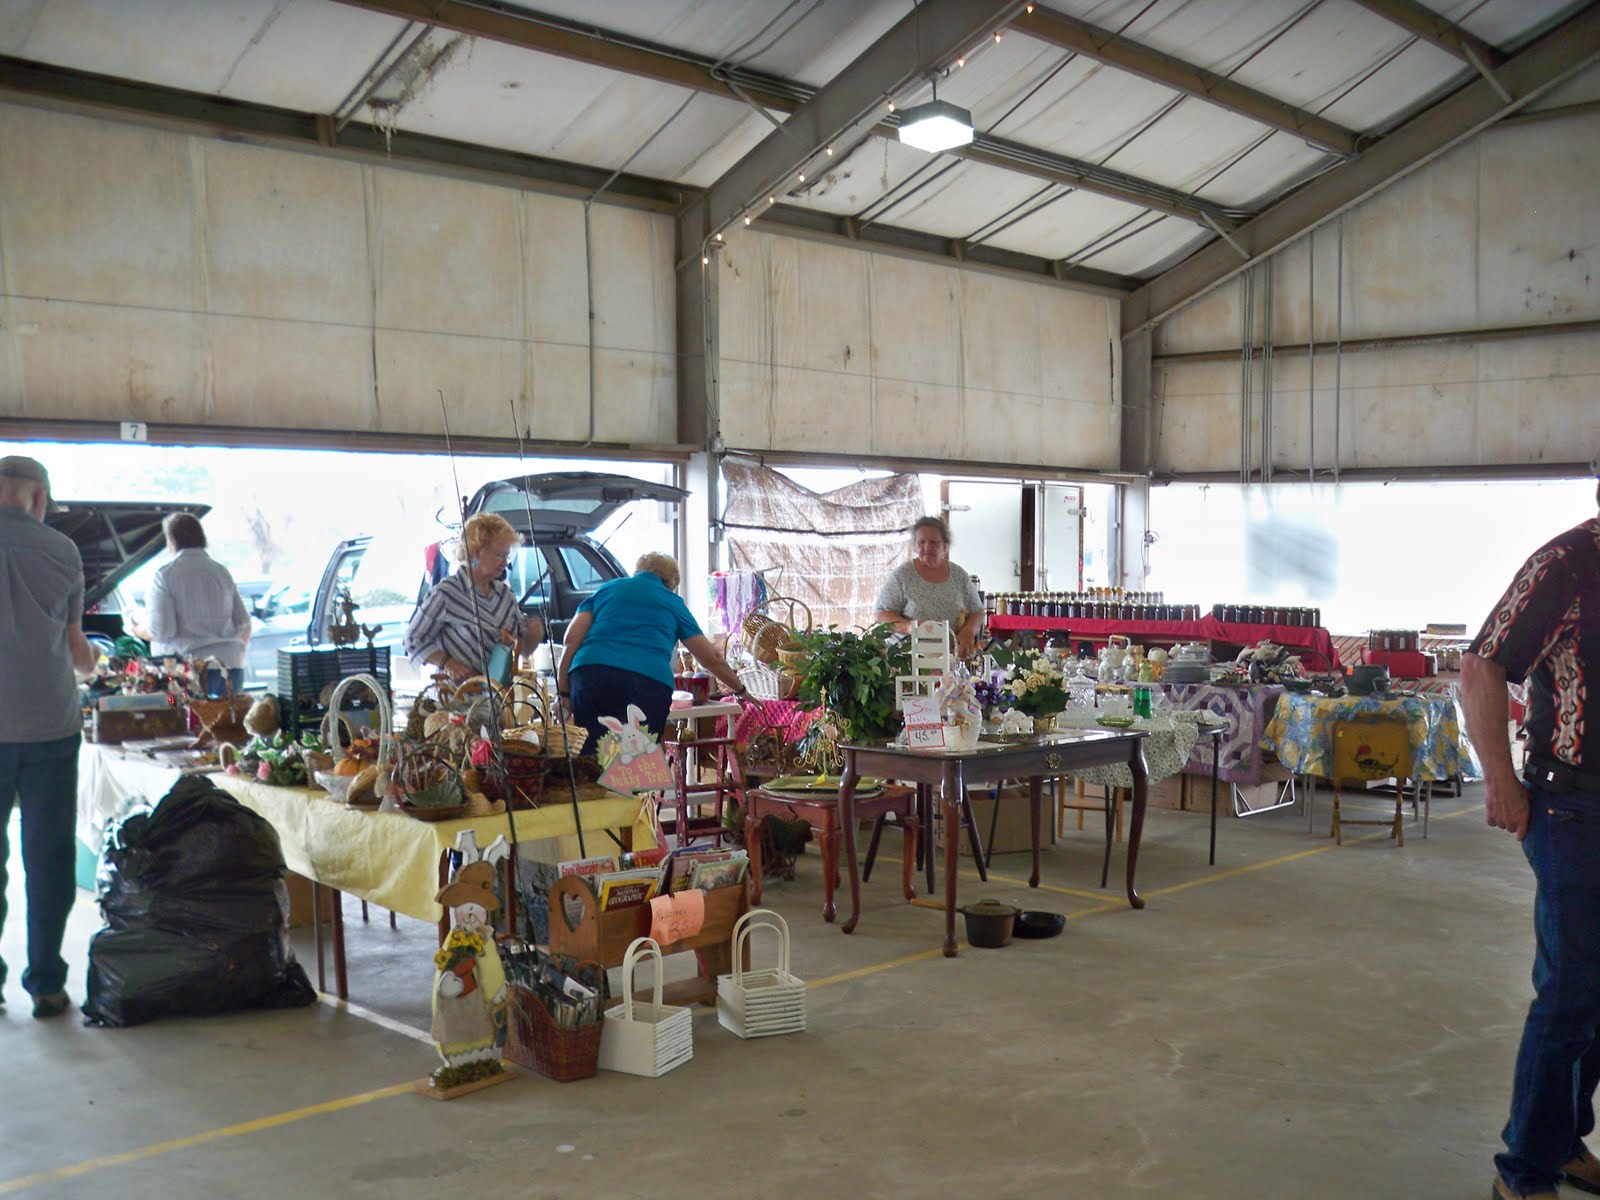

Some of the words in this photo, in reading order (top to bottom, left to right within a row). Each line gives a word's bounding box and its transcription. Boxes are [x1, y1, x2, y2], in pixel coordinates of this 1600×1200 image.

[130, 424, 139, 439] 7
[618, 766, 633, 776] To
[638, 759, 656, 772] the
[609, 774, 640, 788] Bunny
[645, 768, 669, 785] Trail
[616, 887, 640, 896] NATIONAL
[608, 893, 642, 906] GEOGRAPHIC
